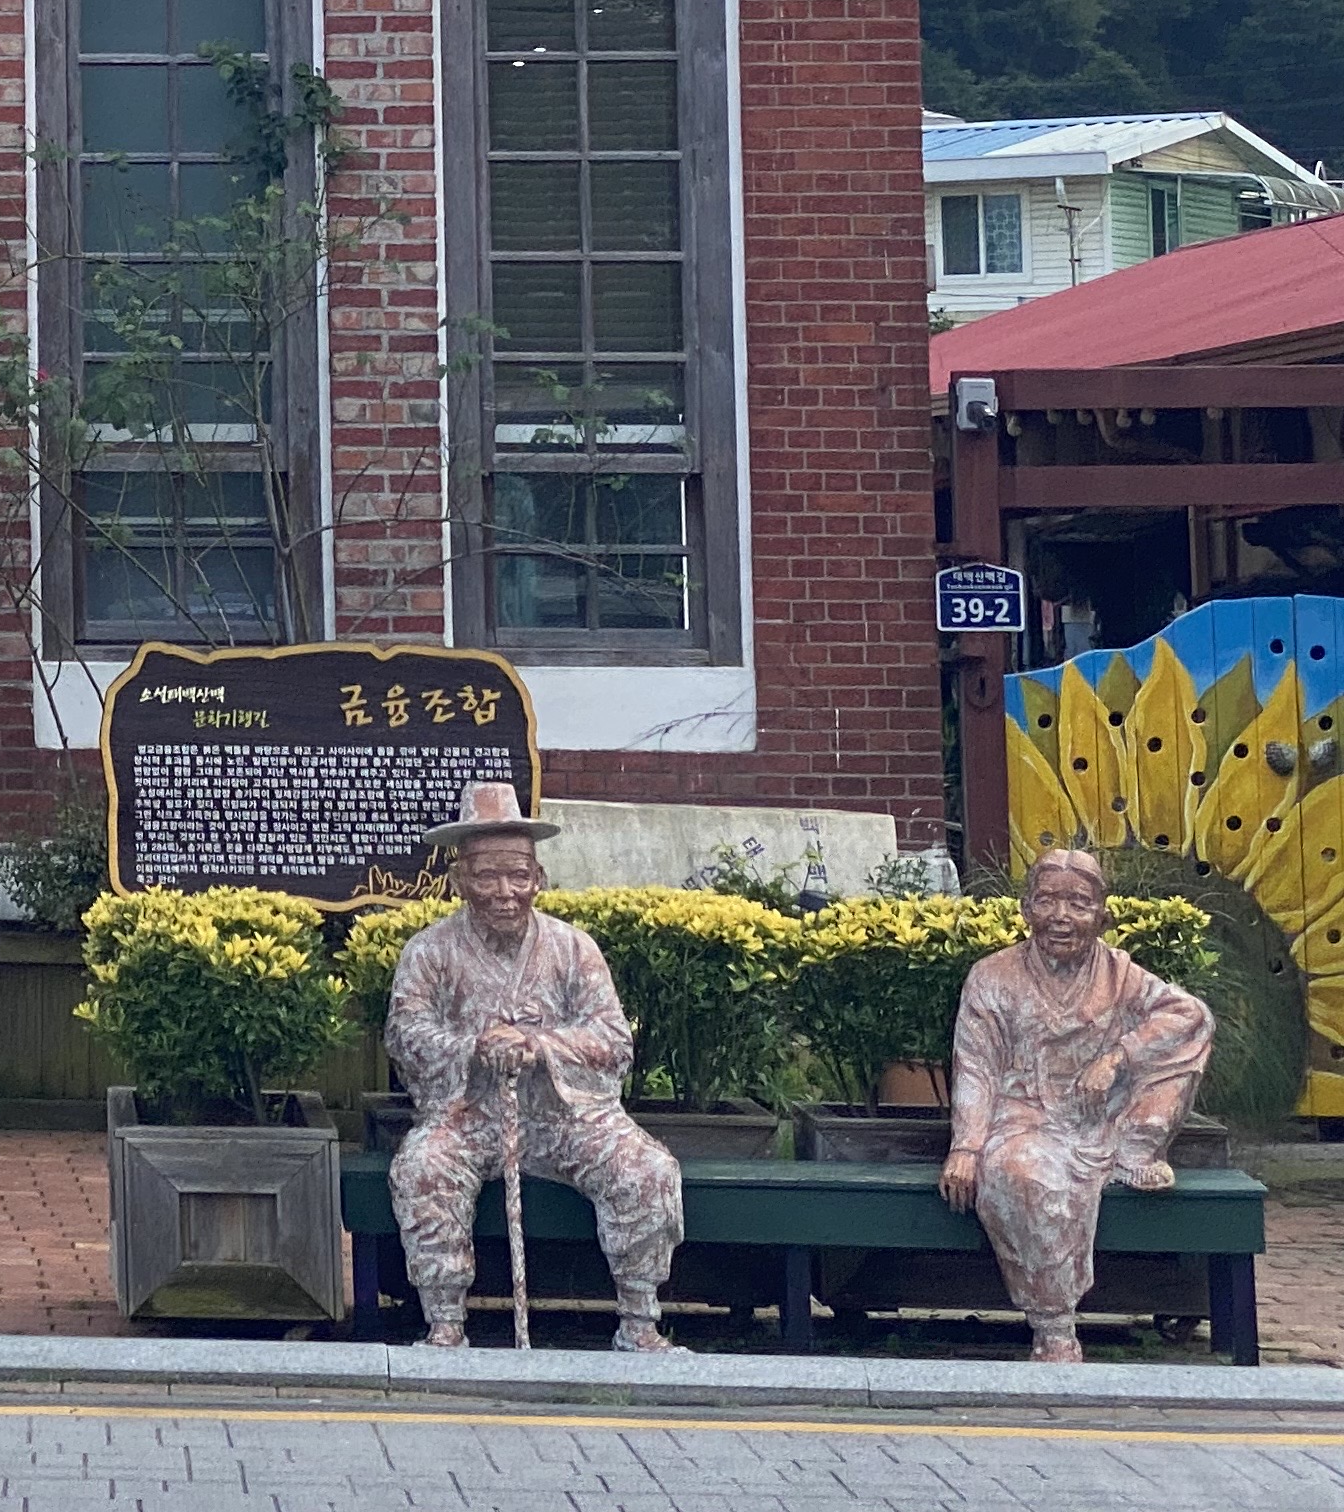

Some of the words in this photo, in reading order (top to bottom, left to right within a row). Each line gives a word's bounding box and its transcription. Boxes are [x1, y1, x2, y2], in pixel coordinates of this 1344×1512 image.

[952, 570, 1006, 583] 태백산맥길
[950, 597, 1011, 624] 39-2
[338, 683, 503, 728] 금융조합
[191, 709, 272, 729] 문학기행길
